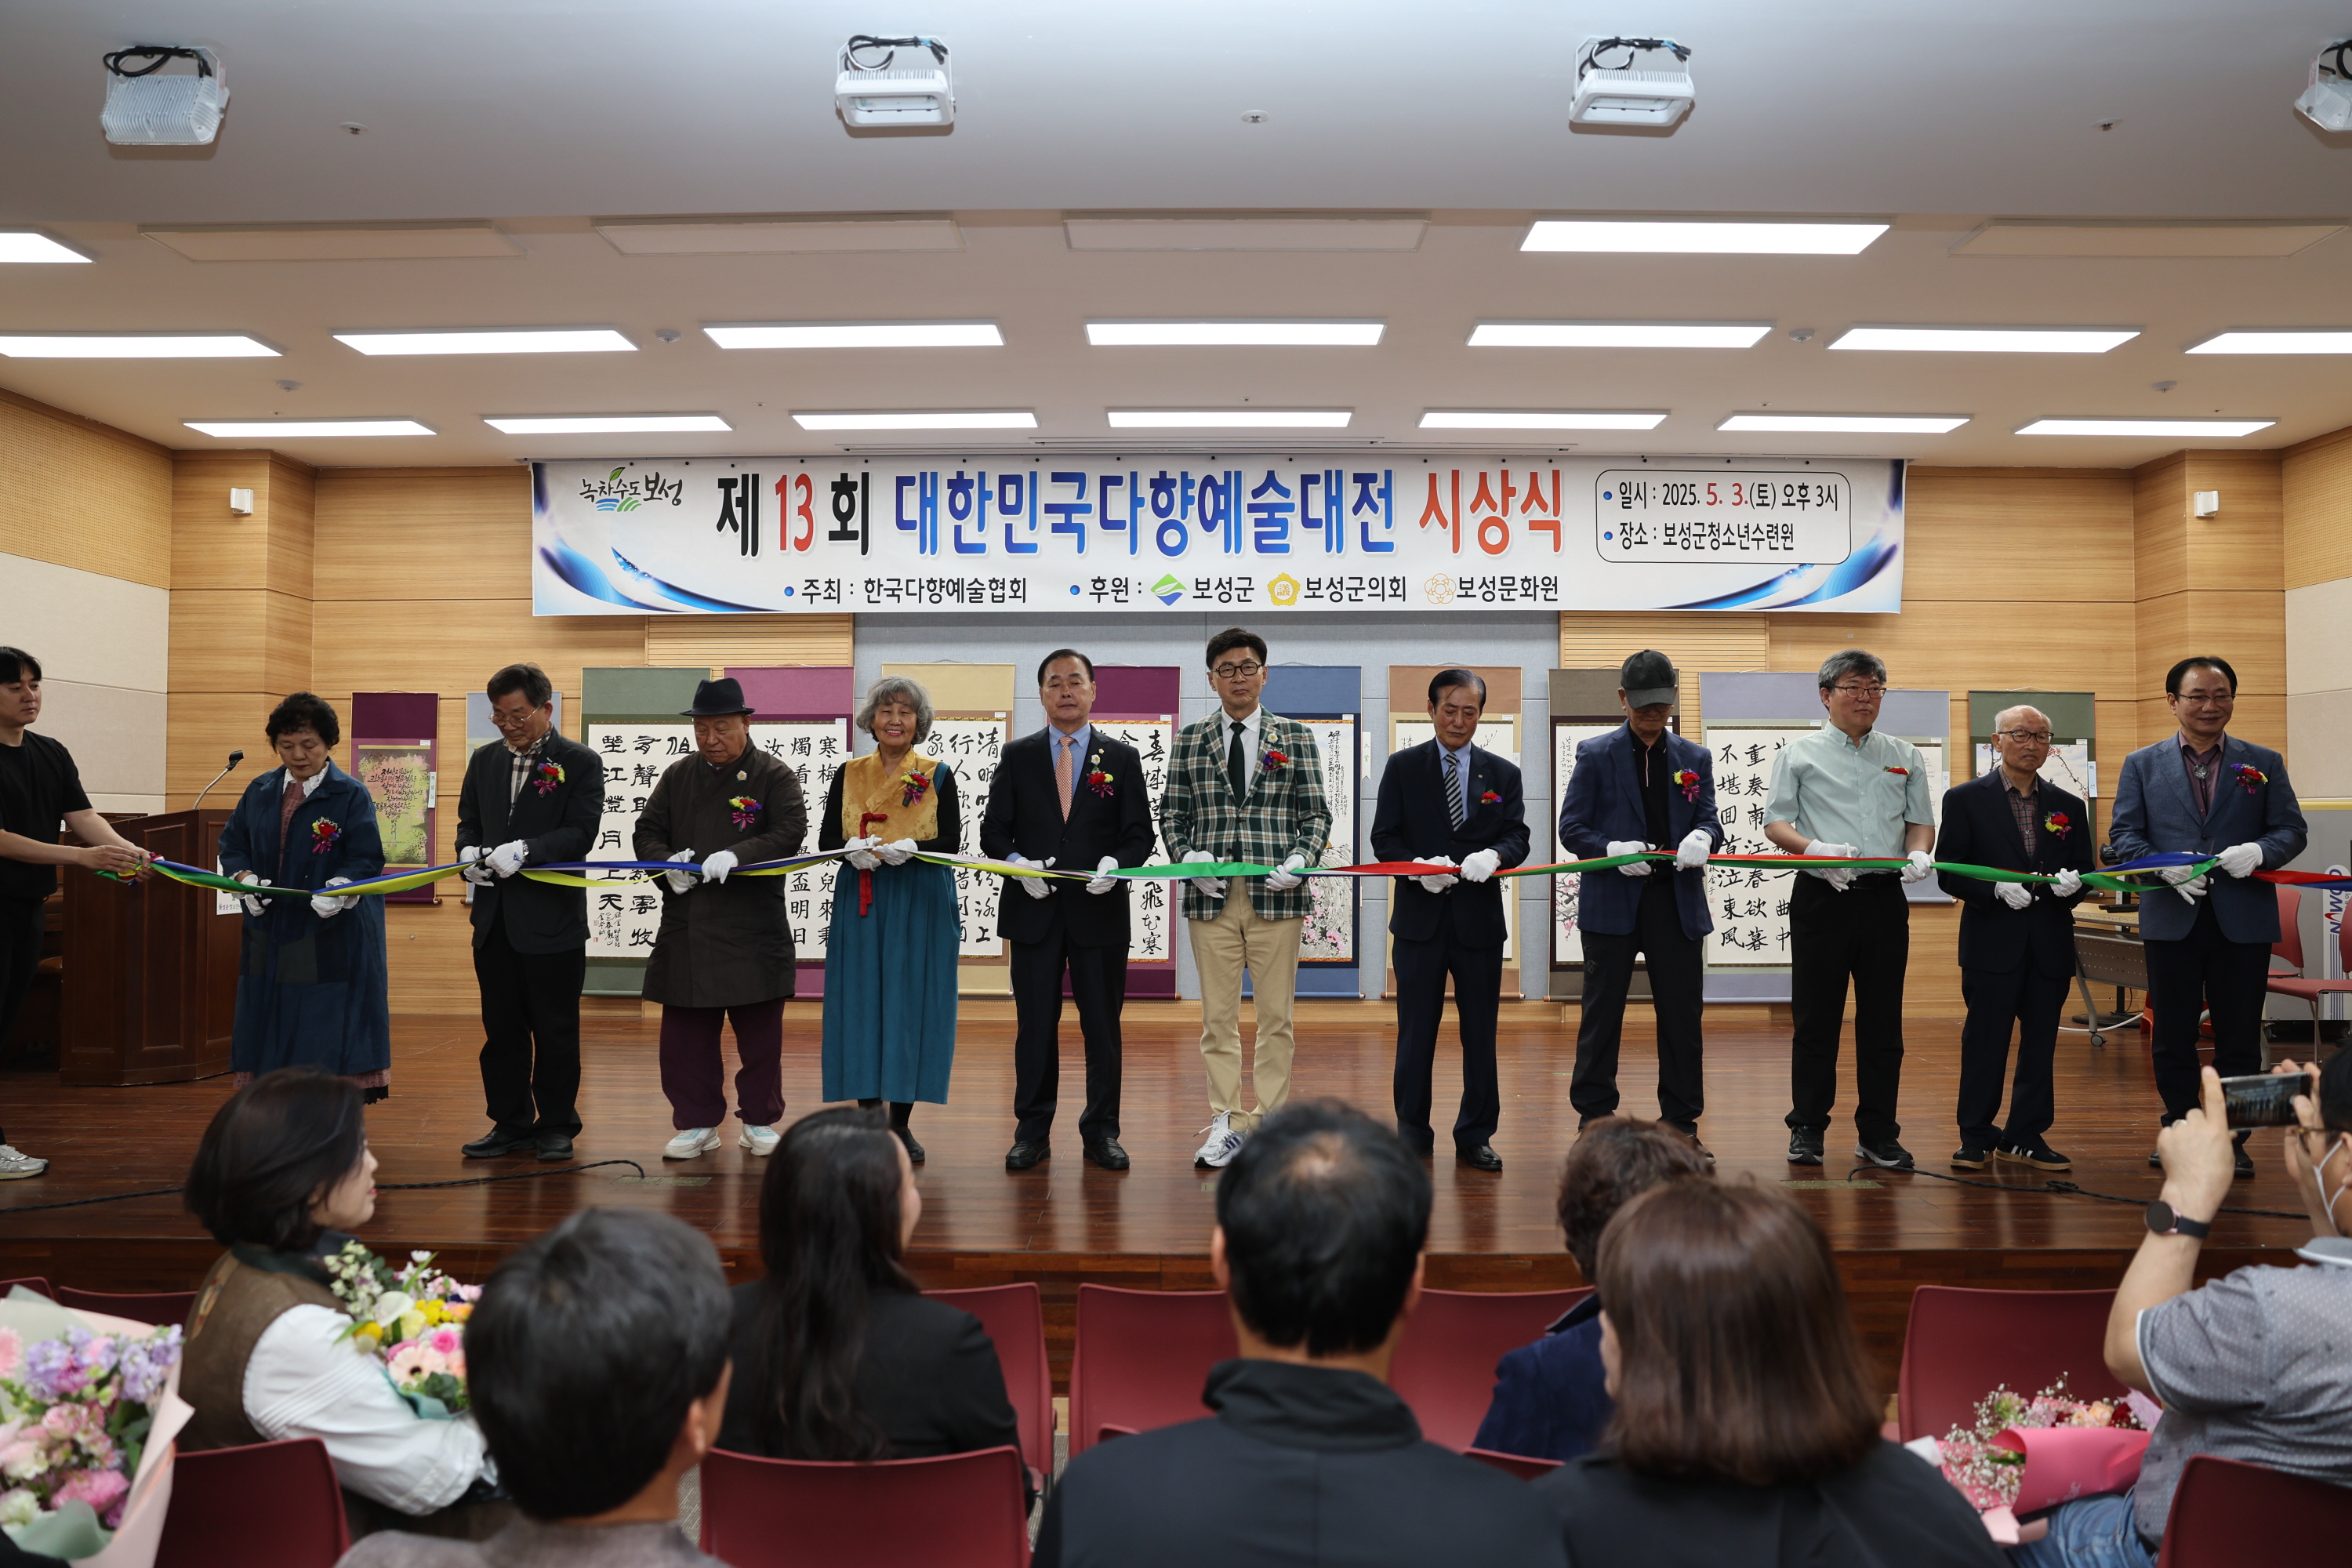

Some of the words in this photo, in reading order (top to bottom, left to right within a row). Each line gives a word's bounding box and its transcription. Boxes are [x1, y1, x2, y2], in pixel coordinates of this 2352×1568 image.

[1662, 484, 1700, 506] 2025.
[1781, 483, 1811, 510] 오후
[1816, 484, 1838, 512] 3시
[895, 470, 1395, 557] 대한민국다향예술대전
[1419, 470, 1561, 555] 시상식
[1663, 521, 1794, 551] 보성군청소년수련원
[864, 577, 1026, 604] 한국다향예술협회
[1192, 576, 1255, 604] 보성군
[1304, 575, 1406, 603] 보성군의회
[1457, 575, 1559, 603] 보성문화원
